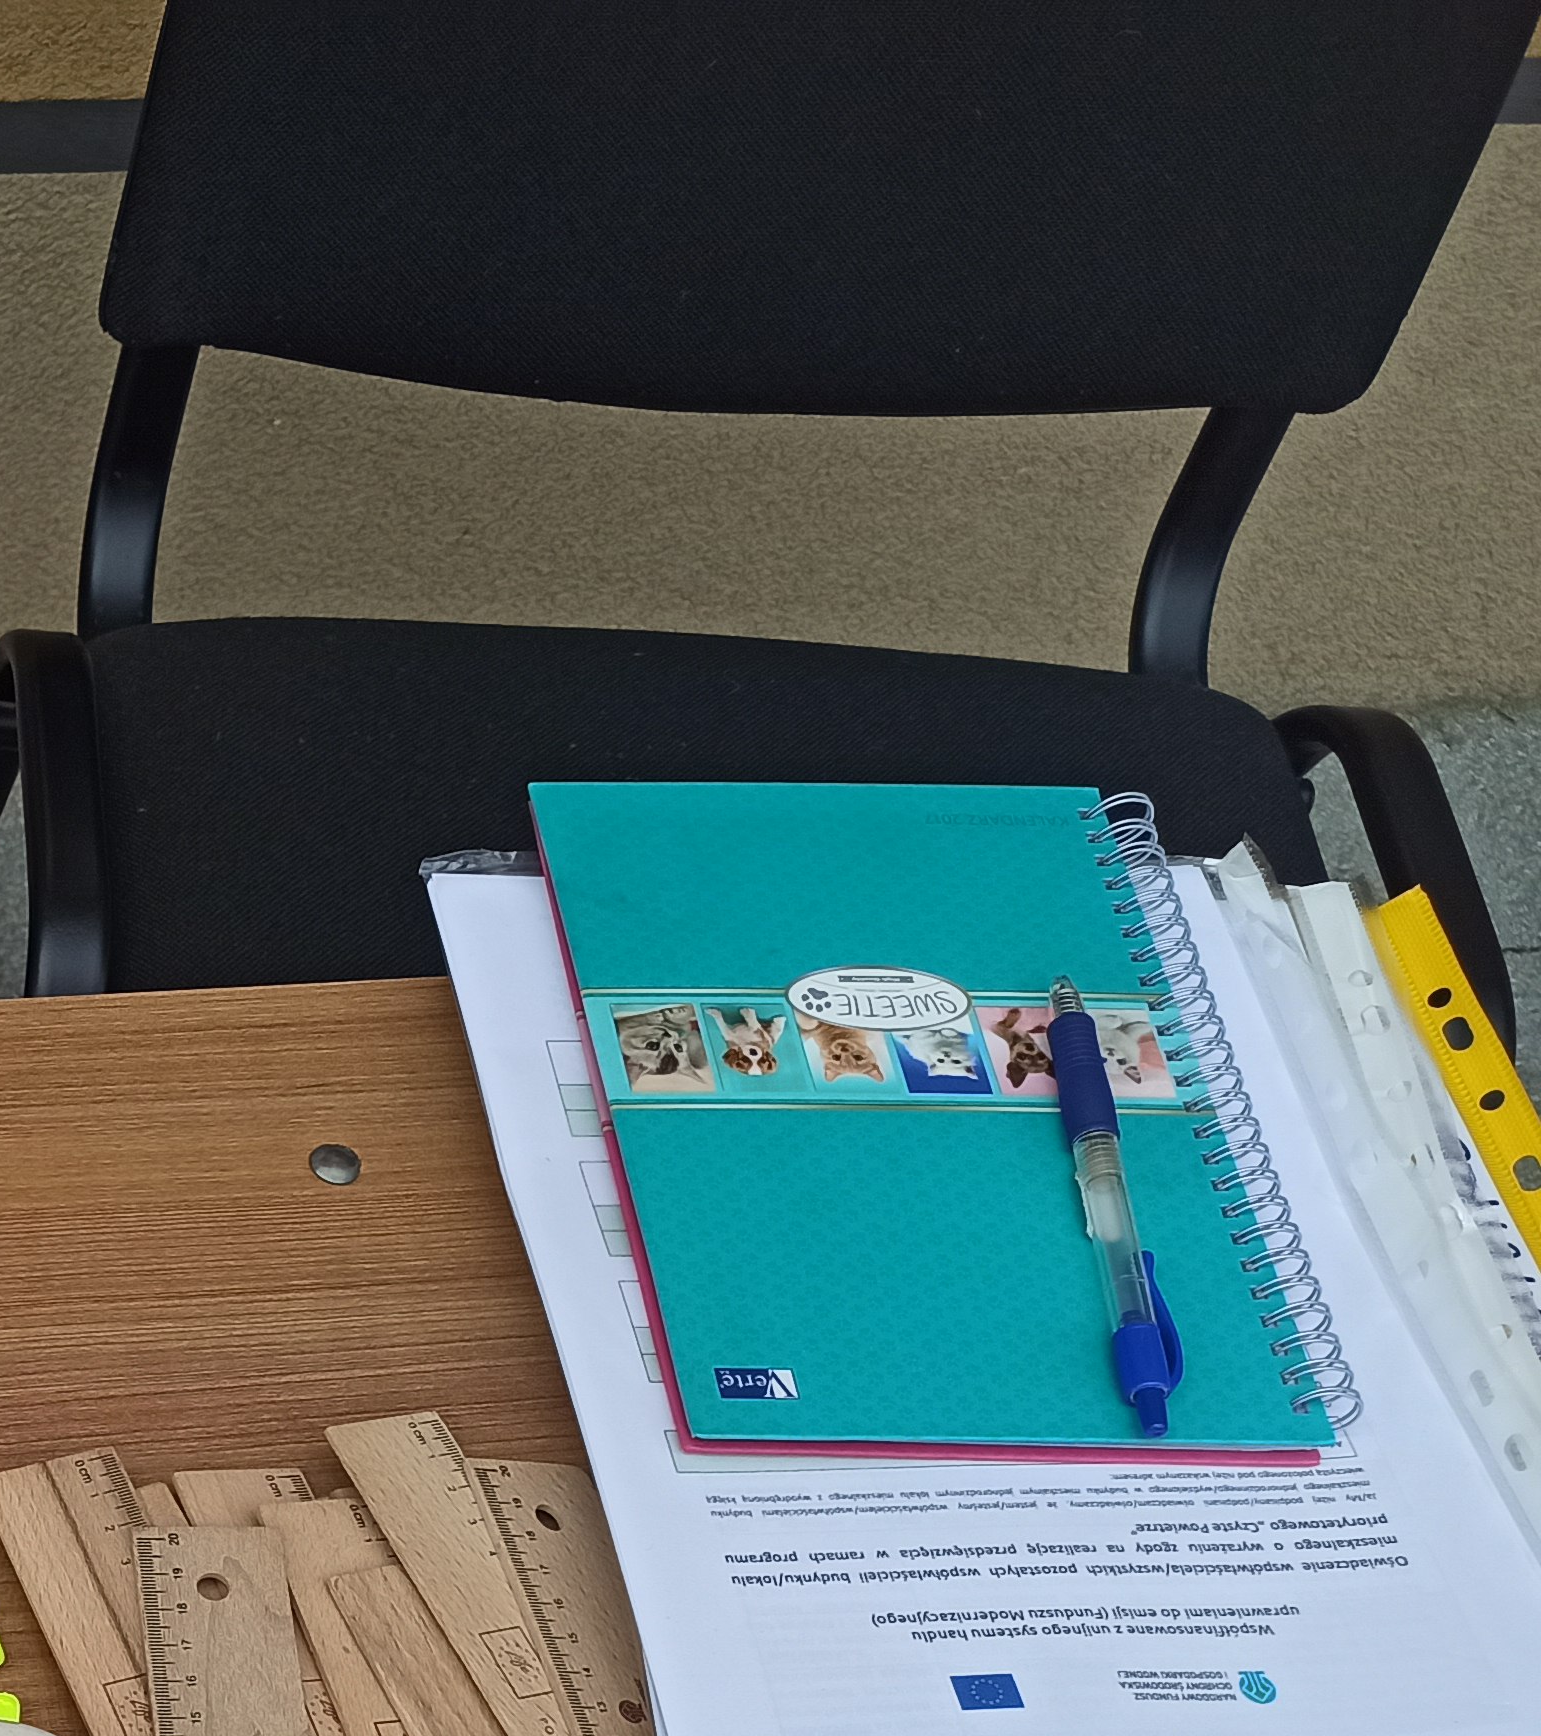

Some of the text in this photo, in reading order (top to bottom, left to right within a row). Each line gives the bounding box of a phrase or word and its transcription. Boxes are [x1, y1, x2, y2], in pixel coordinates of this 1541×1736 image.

[831, 990, 958, 1019] SWEETIE
[720, 1368, 797, 1398] Verte
[168, 1532, 180, 1546] 20
[731, 1555, 1408, 1586] Oświadczenie współwłaściciela/wszystkich pozostałych współwłaścicieli budynku/lokalu
[176, 1602, 188, 1615] 18
[871, 1604, 1299, 1627] uprawnieniami do emisji (Funduszu Modernizacyjnego)
[911, 1622, 1274, 1642] Współfinansowane z unijnego systemu handlu
[185, 1675, 197, 1688] 16
[190, 1711, 202, 1724] 15
